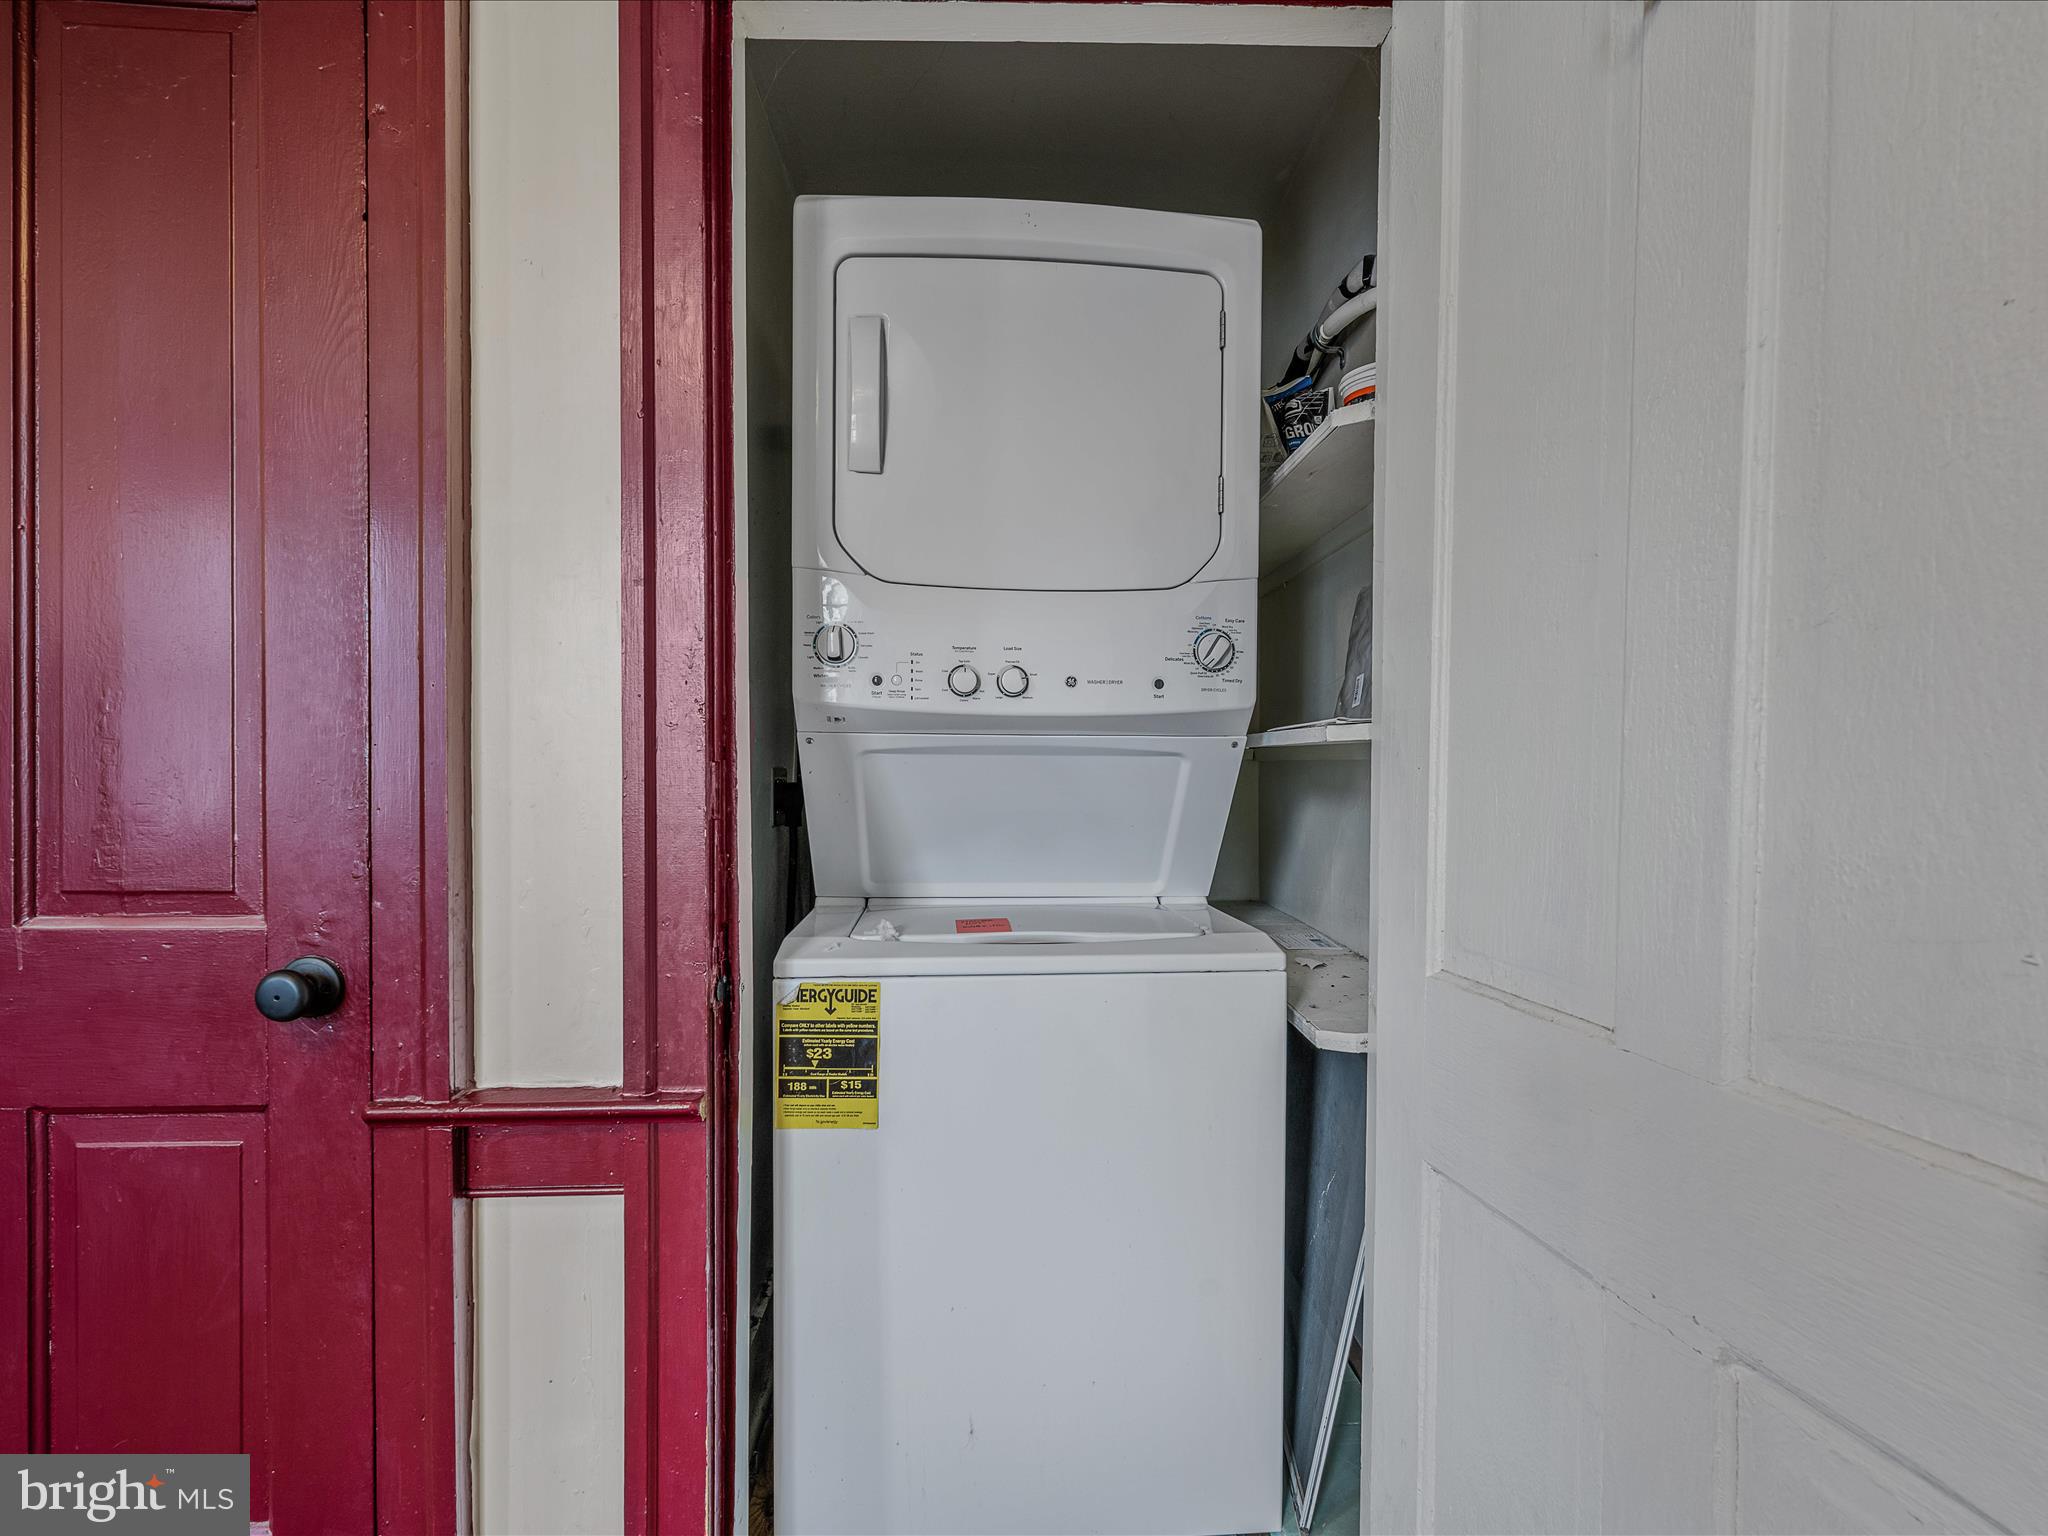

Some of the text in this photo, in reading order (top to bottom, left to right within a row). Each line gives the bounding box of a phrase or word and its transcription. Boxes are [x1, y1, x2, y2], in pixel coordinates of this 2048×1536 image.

[806, 1048, 832, 1059] $23
[788, 1082, 807, 1091] 188
[841, 1081, 862, 1090] $15
